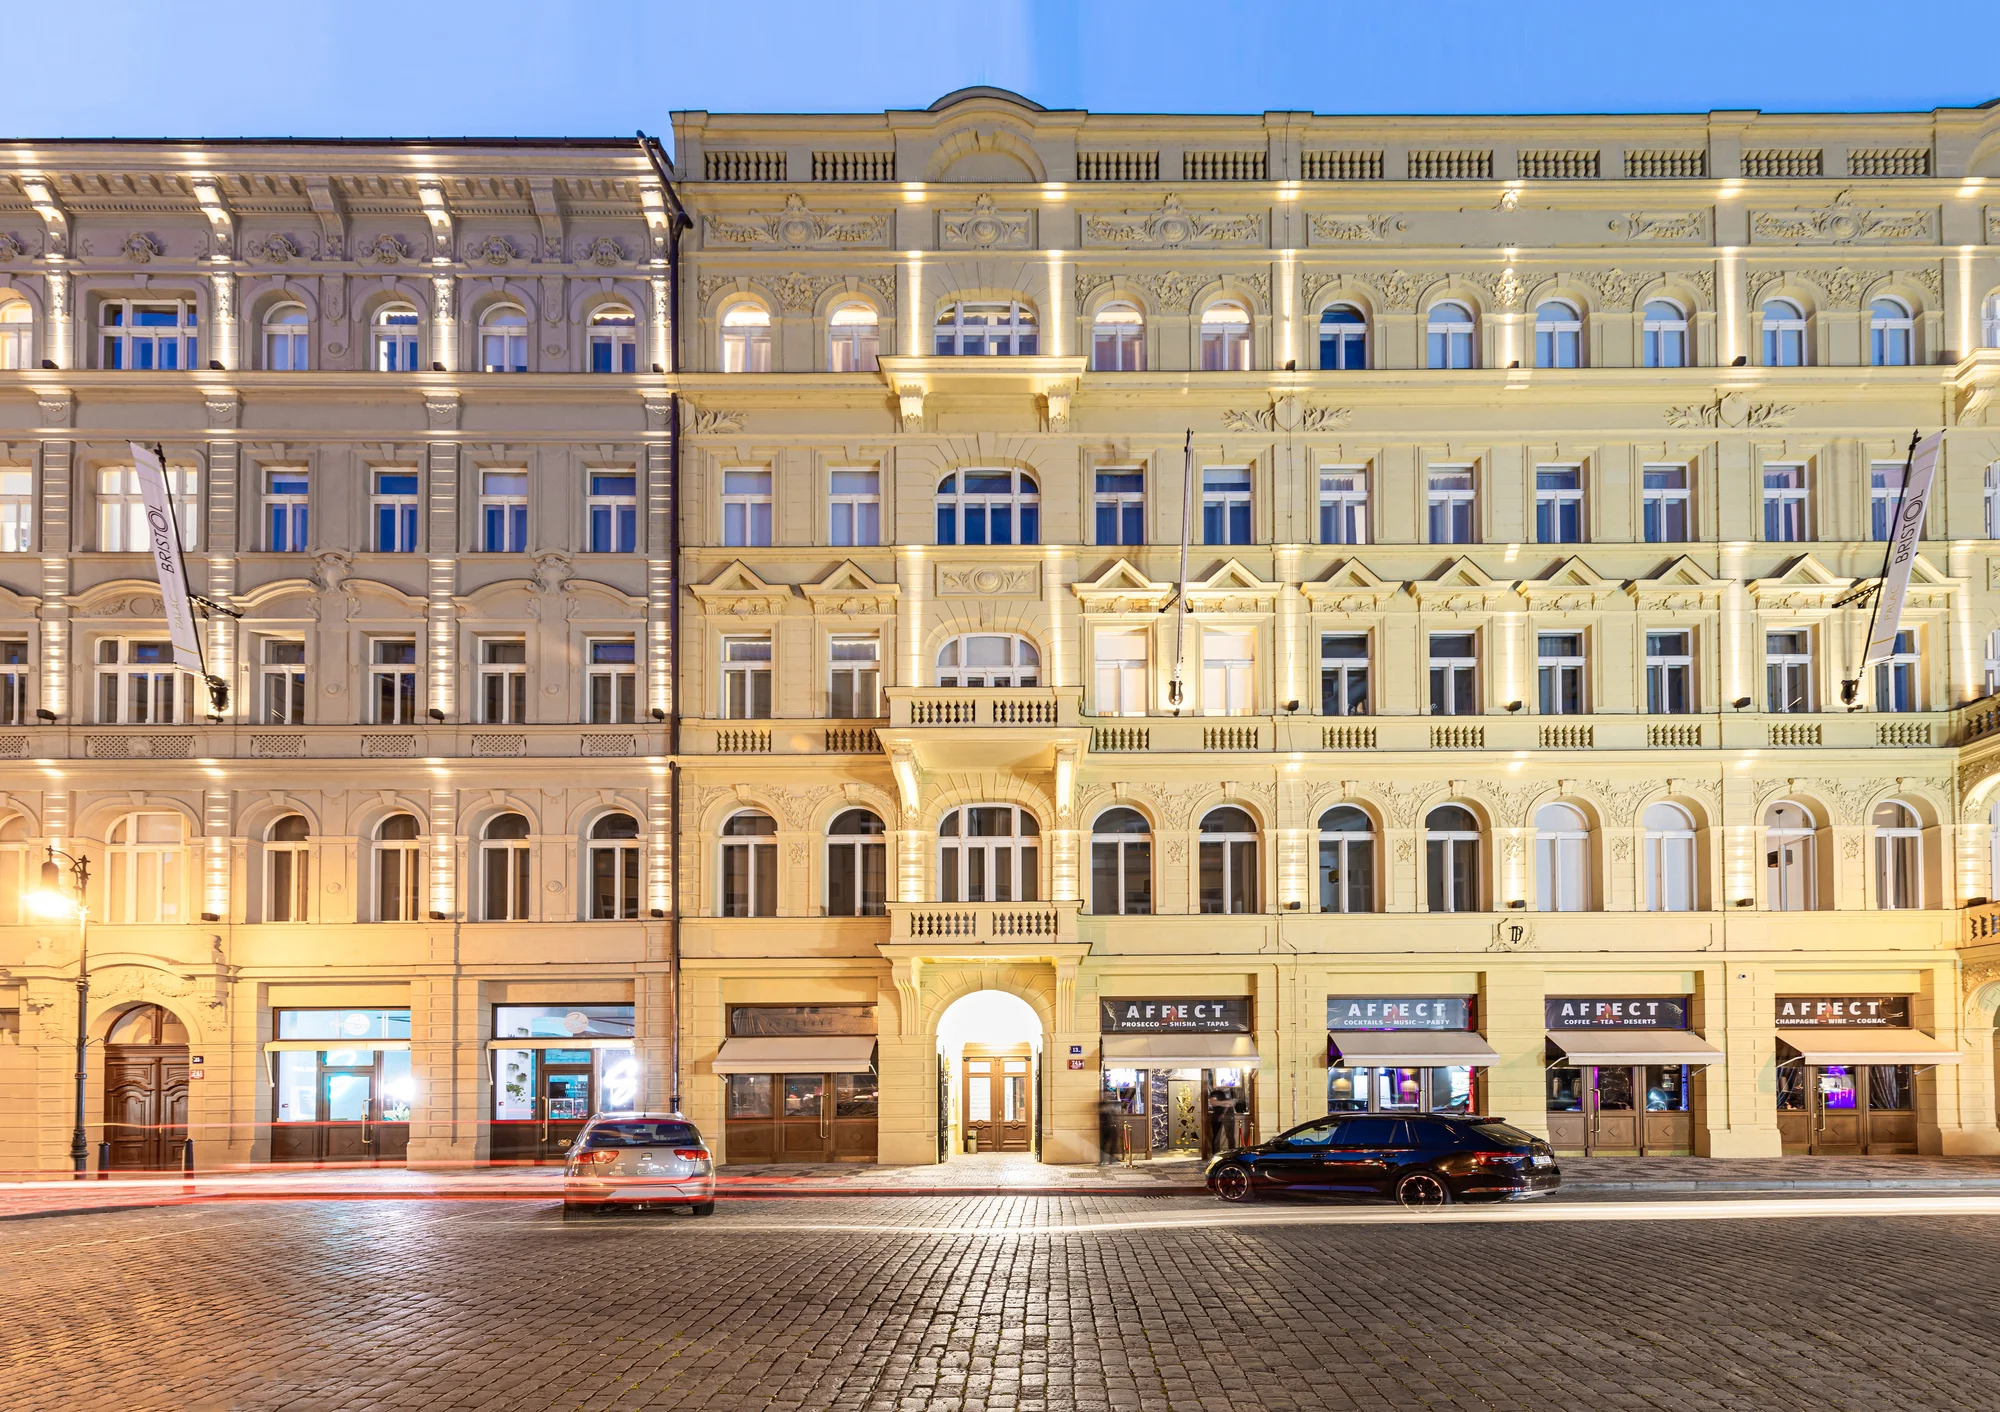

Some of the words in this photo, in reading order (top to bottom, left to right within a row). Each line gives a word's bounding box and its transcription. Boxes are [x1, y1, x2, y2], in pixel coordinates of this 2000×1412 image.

[1895, 488, 1924, 564] BRISTOL
[148, 505, 174, 574] BRISTOL
[1126, 1005, 1224, 1018] AFFECT
[1348, 1003, 1446, 1016] AFFECT
[1561, 1002, 1659, 1016] AFFECT
[1782, 1002, 1879, 1015] AFFECT
